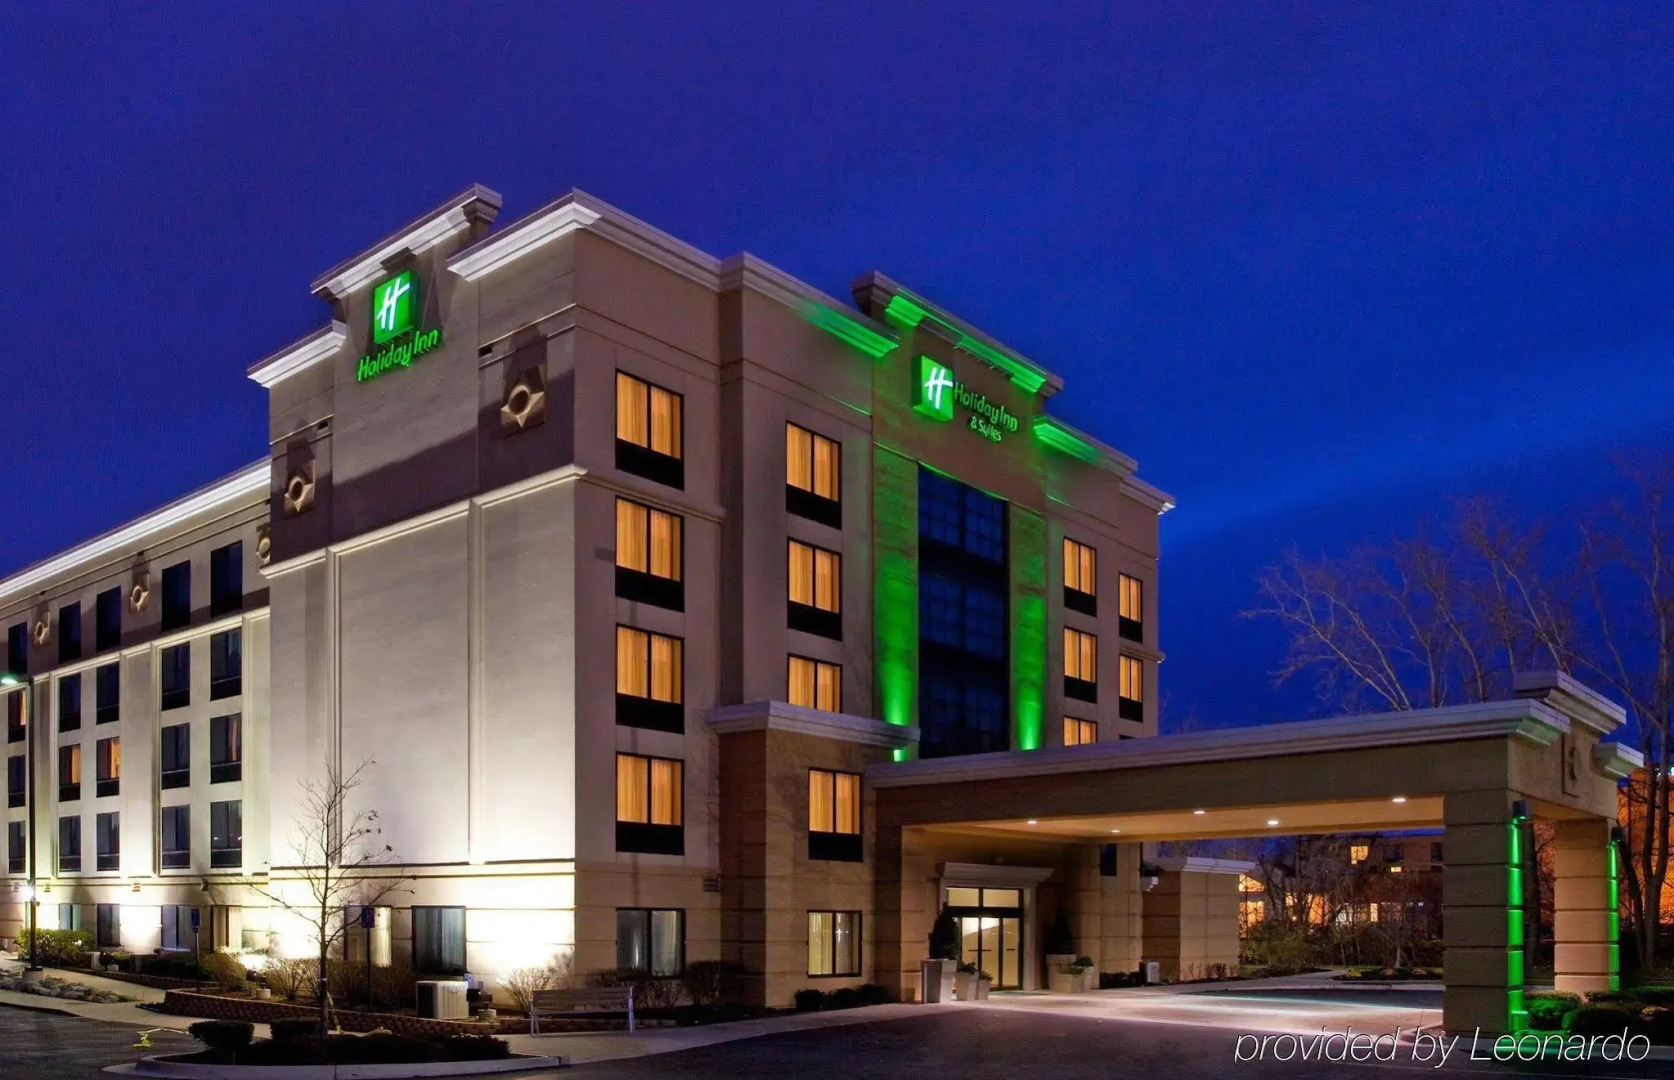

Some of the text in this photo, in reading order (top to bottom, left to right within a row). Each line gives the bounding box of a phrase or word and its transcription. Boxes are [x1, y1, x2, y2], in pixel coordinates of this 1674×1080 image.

[357, 329, 439, 382] Holiday Inn
[953, 381, 1018, 432] Holiday Inn
[970, 416, 1002, 441] & Suites
